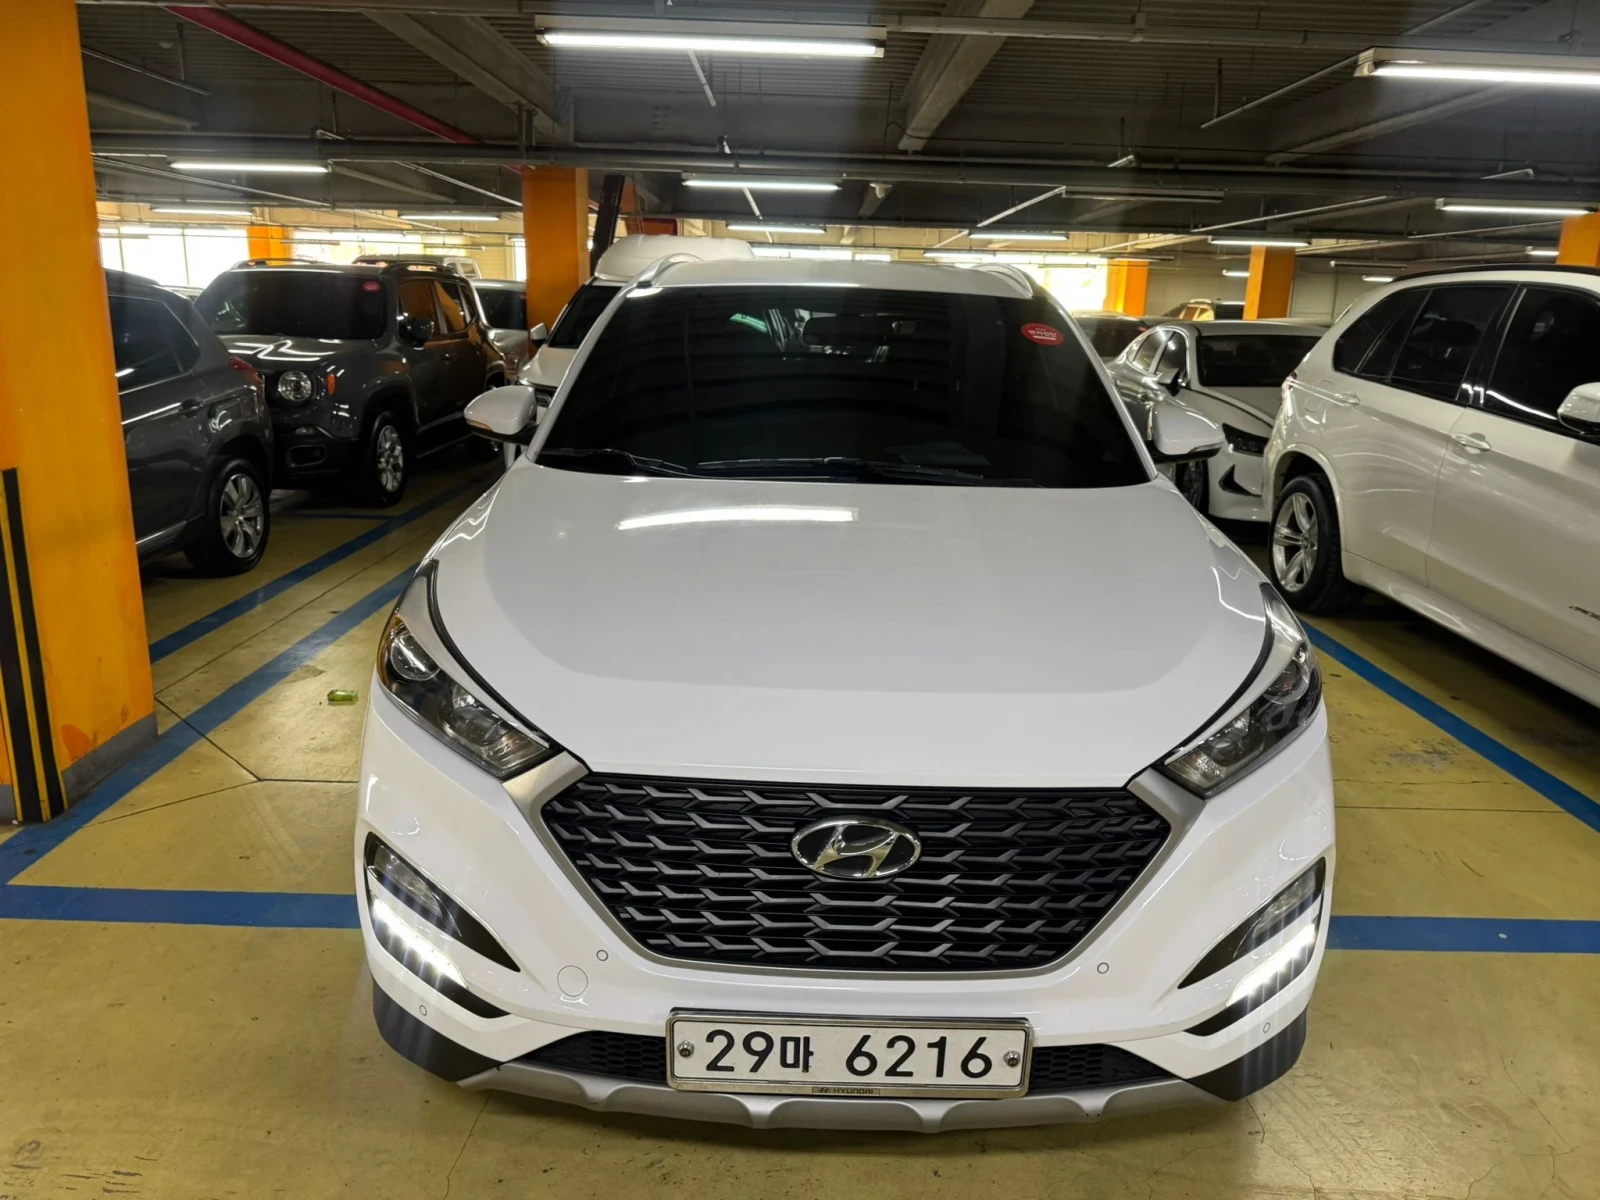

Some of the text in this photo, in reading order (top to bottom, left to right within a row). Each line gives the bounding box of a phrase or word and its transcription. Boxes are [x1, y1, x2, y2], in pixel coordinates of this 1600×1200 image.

[705, 1029, 993, 1079] 29마 6216
[833, 1087, 874, 1095] HYUNDAI
